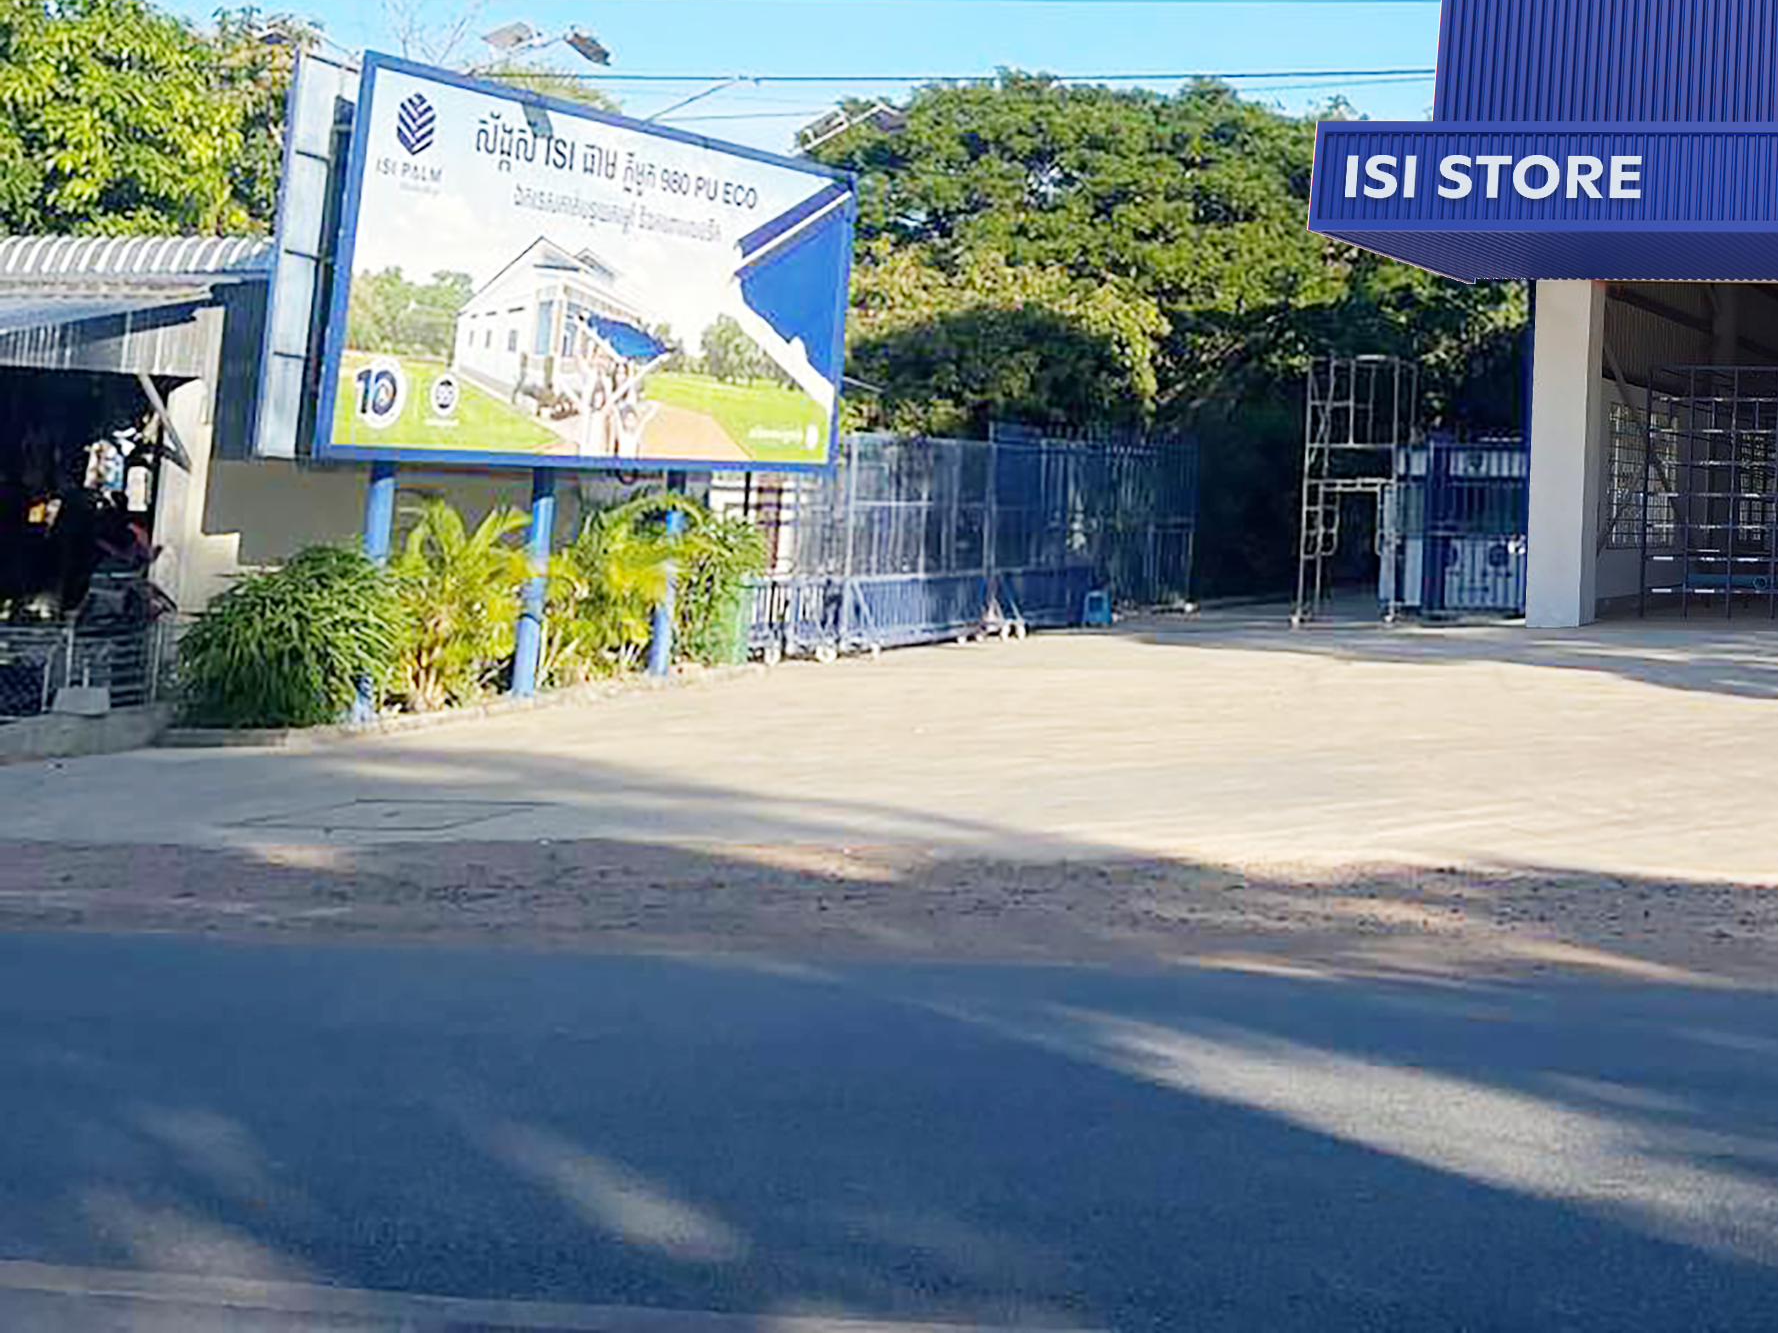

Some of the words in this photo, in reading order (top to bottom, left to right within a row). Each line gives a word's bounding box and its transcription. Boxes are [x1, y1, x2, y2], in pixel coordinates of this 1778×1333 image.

[545, 136, 575, 171] ISI
[694, 176, 719, 201] PU
[722, 181, 758, 209] ECO
[1344, 154, 1418, 199] ISI
[1437, 154, 1643, 200] STORE
